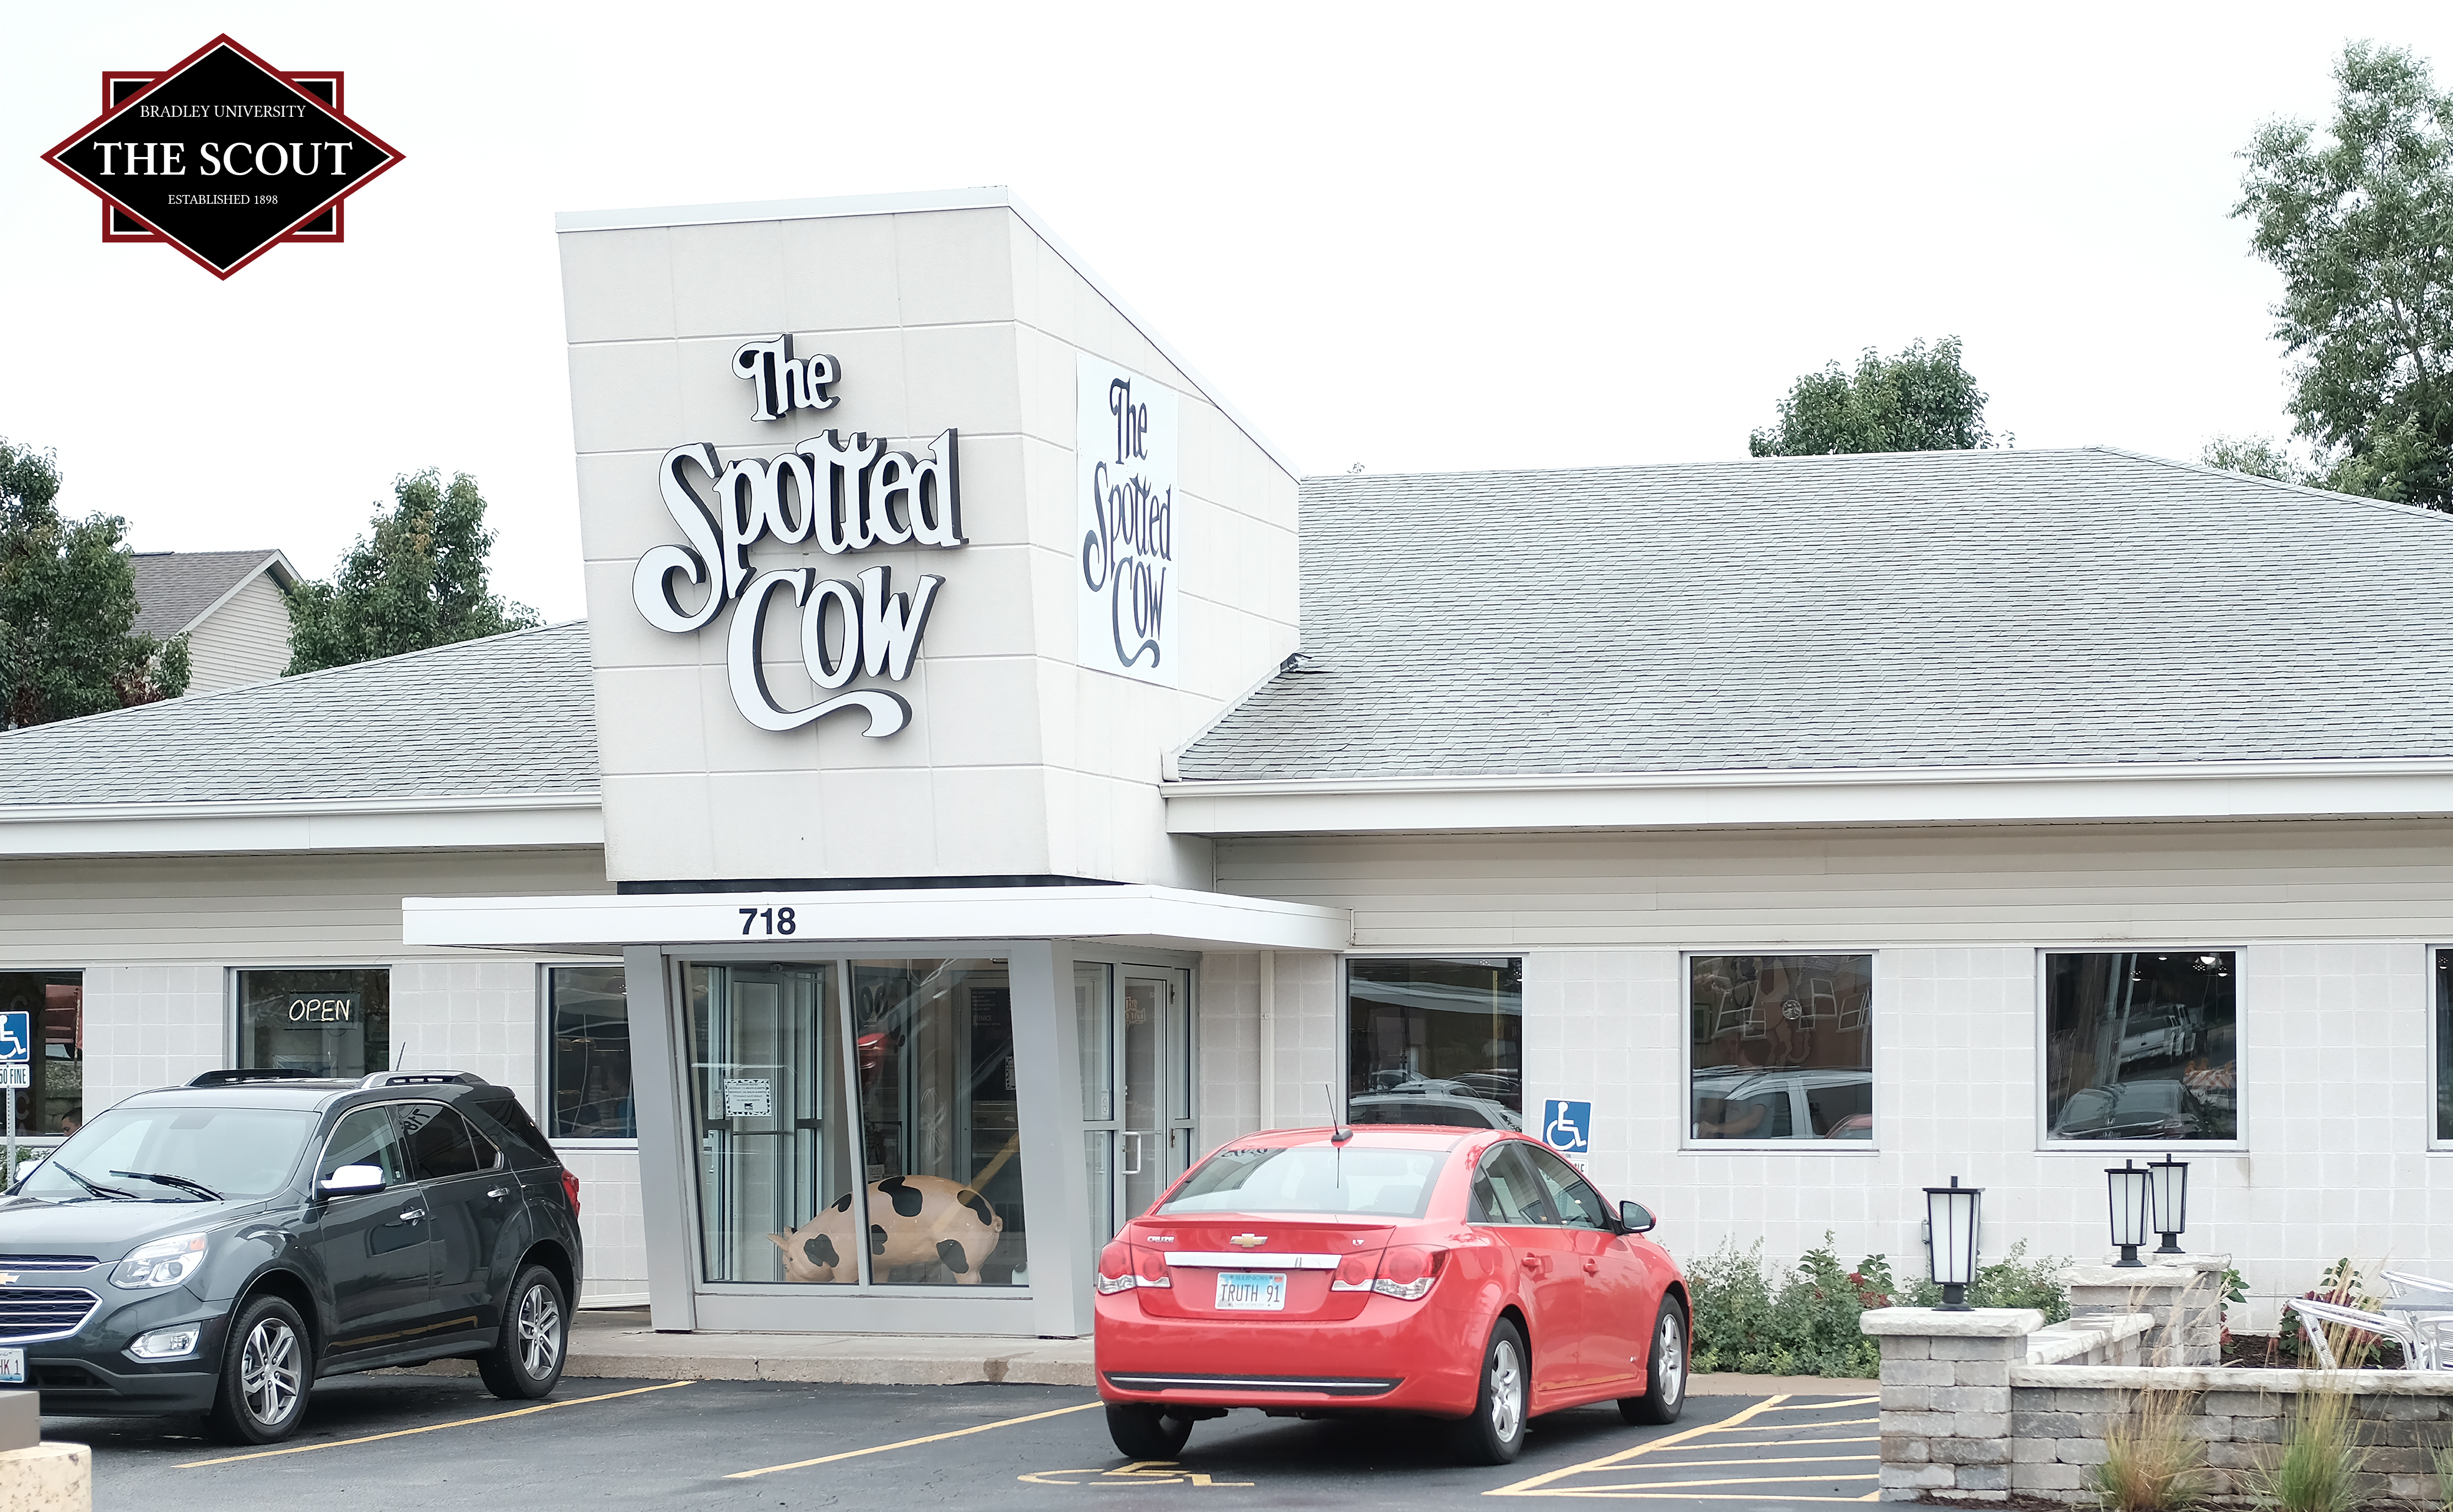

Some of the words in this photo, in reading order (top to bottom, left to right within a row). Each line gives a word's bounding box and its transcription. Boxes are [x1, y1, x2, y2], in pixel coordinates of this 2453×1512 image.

[732, 334, 841, 422] The
[1109, 376, 1148, 465] The
[632, 427, 970, 633] Spotted
[1082, 460, 1172, 592] Spotted
[739, 907, 796, 935] 718
[289, 999, 350, 1022] OPEN
[10, 1068, 26, 1084] FINE
[1221, 1284, 1259, 1302] TRUTH
[1266, 1285, 1280, 1303] 91
